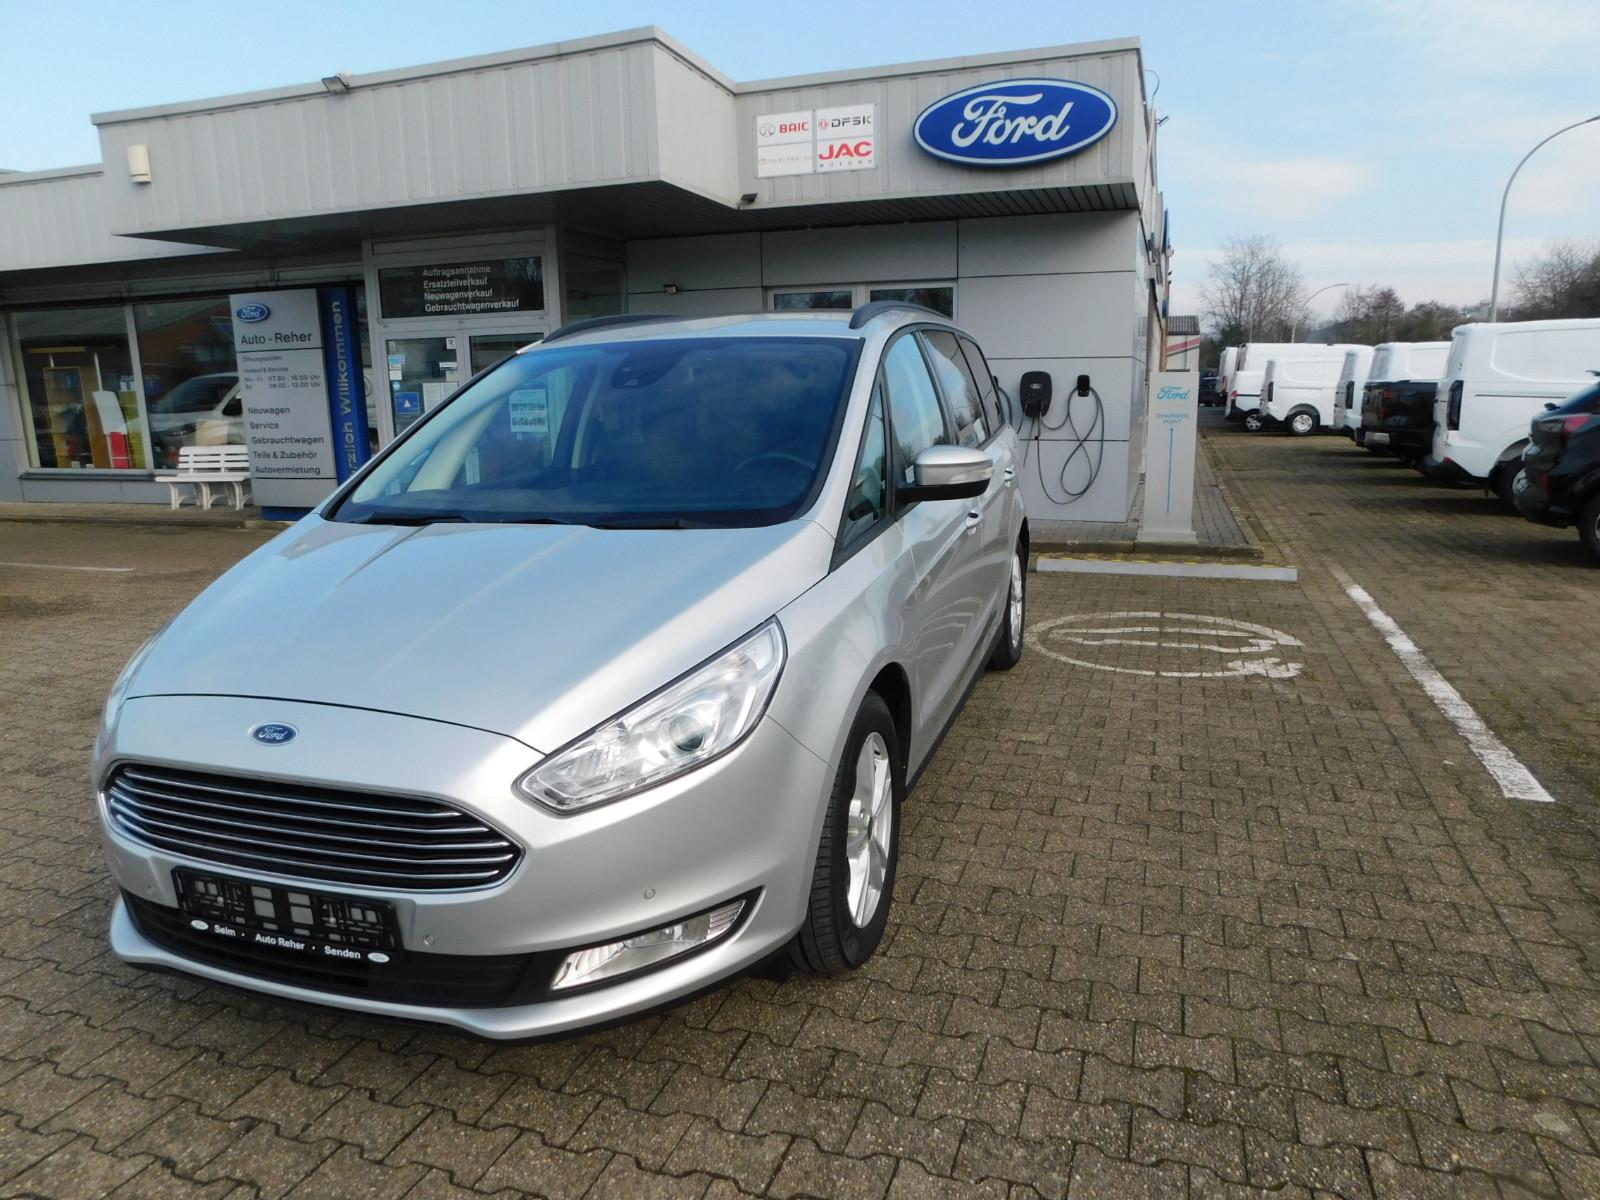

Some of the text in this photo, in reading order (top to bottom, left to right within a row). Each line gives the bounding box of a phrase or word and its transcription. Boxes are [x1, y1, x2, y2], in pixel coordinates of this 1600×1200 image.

[831, 115, 872, 128] DFSK
[951, 92, 1074, 148] Ford
[778, 121, 809, 134] BAIC
[818, 141, 873, 160] JAC
[819, 160, 873, 168] MOTORS
[423, 266, 491, 277] Auftragsannahme
[423, 276, 488, 289] Ersatzteilverkauf
[424, 288, 493, 301] Neuwagenverkauf
[425, 298, 520, 312] Gebrauchtwagenverkauf
[240, 306, 262, 319] Ford
[241, 334, 266, 345] Auto
[274, 331, 313, 343] Reher
[332, 301, 352, 416] Willkommen
[1156, 386, 1191, 400] Ford
[248, 407, 291, 415] Neuwagen
[249, 421, 280, 430] Service
[251, 436, 325, 445] Gebrauchtwagen
[253, 450, 317, 459] Teile & Zubehör
[255, 465, 321, 475] Autovermietung
[258, 725, 289, 740] Ford
[255, 933, 276, 945] Auto
[277, 937, 306, 950] Reher
[324, 945, 361, 960] Senden
